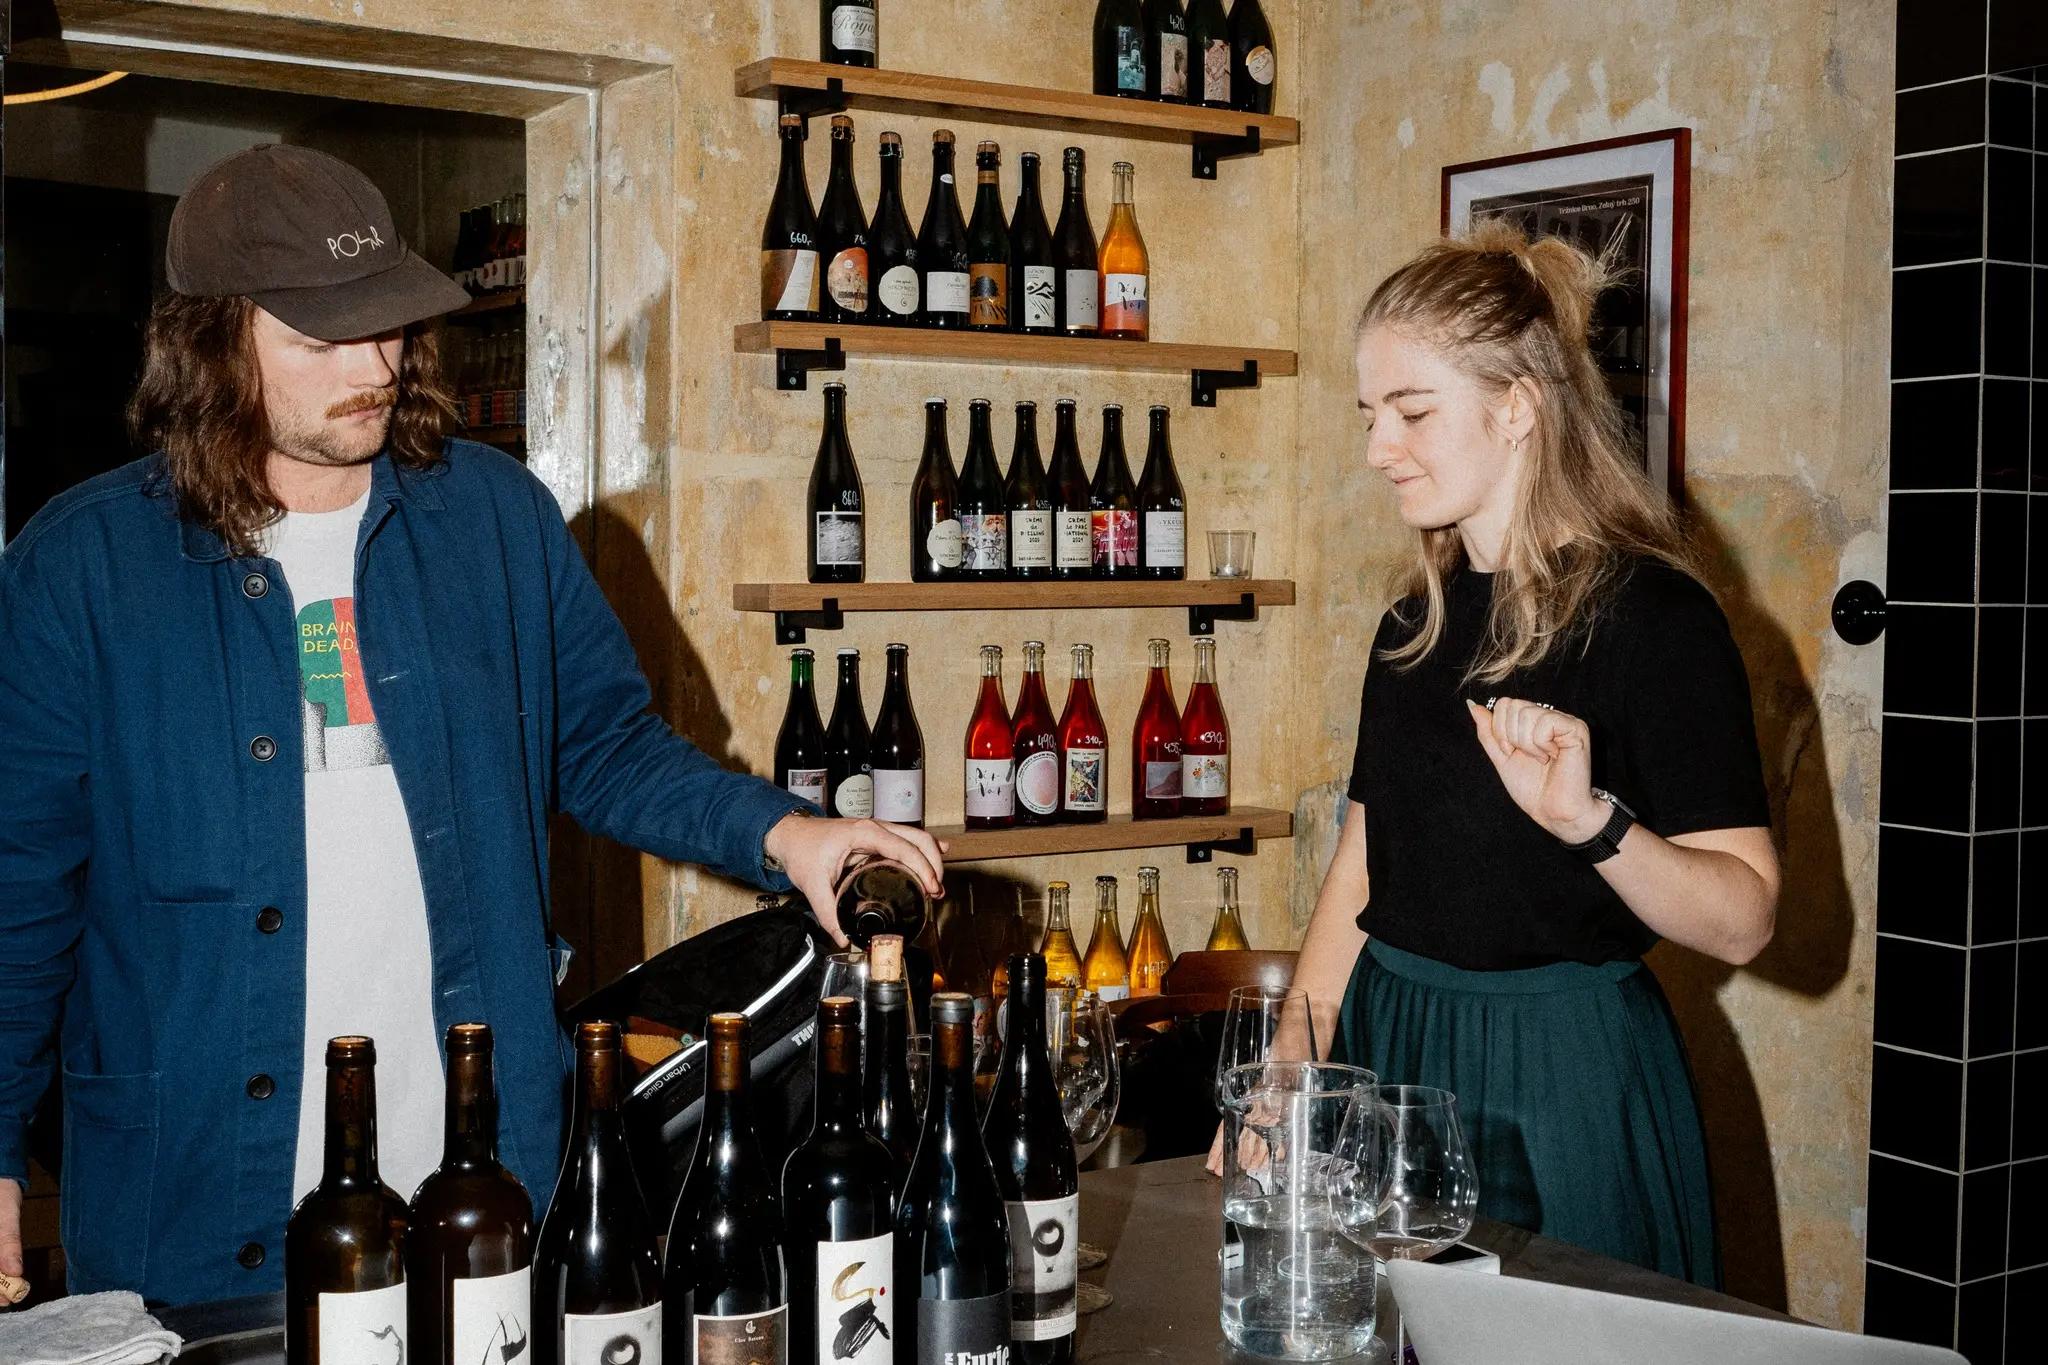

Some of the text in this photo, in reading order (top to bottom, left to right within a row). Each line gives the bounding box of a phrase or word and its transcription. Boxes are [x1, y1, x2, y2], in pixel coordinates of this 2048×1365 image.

[301, 621, 356, 637] BRAIN
[791, 1021, 816, 1047] THU
[642, 1062, 692, 1100] Urban Glide
